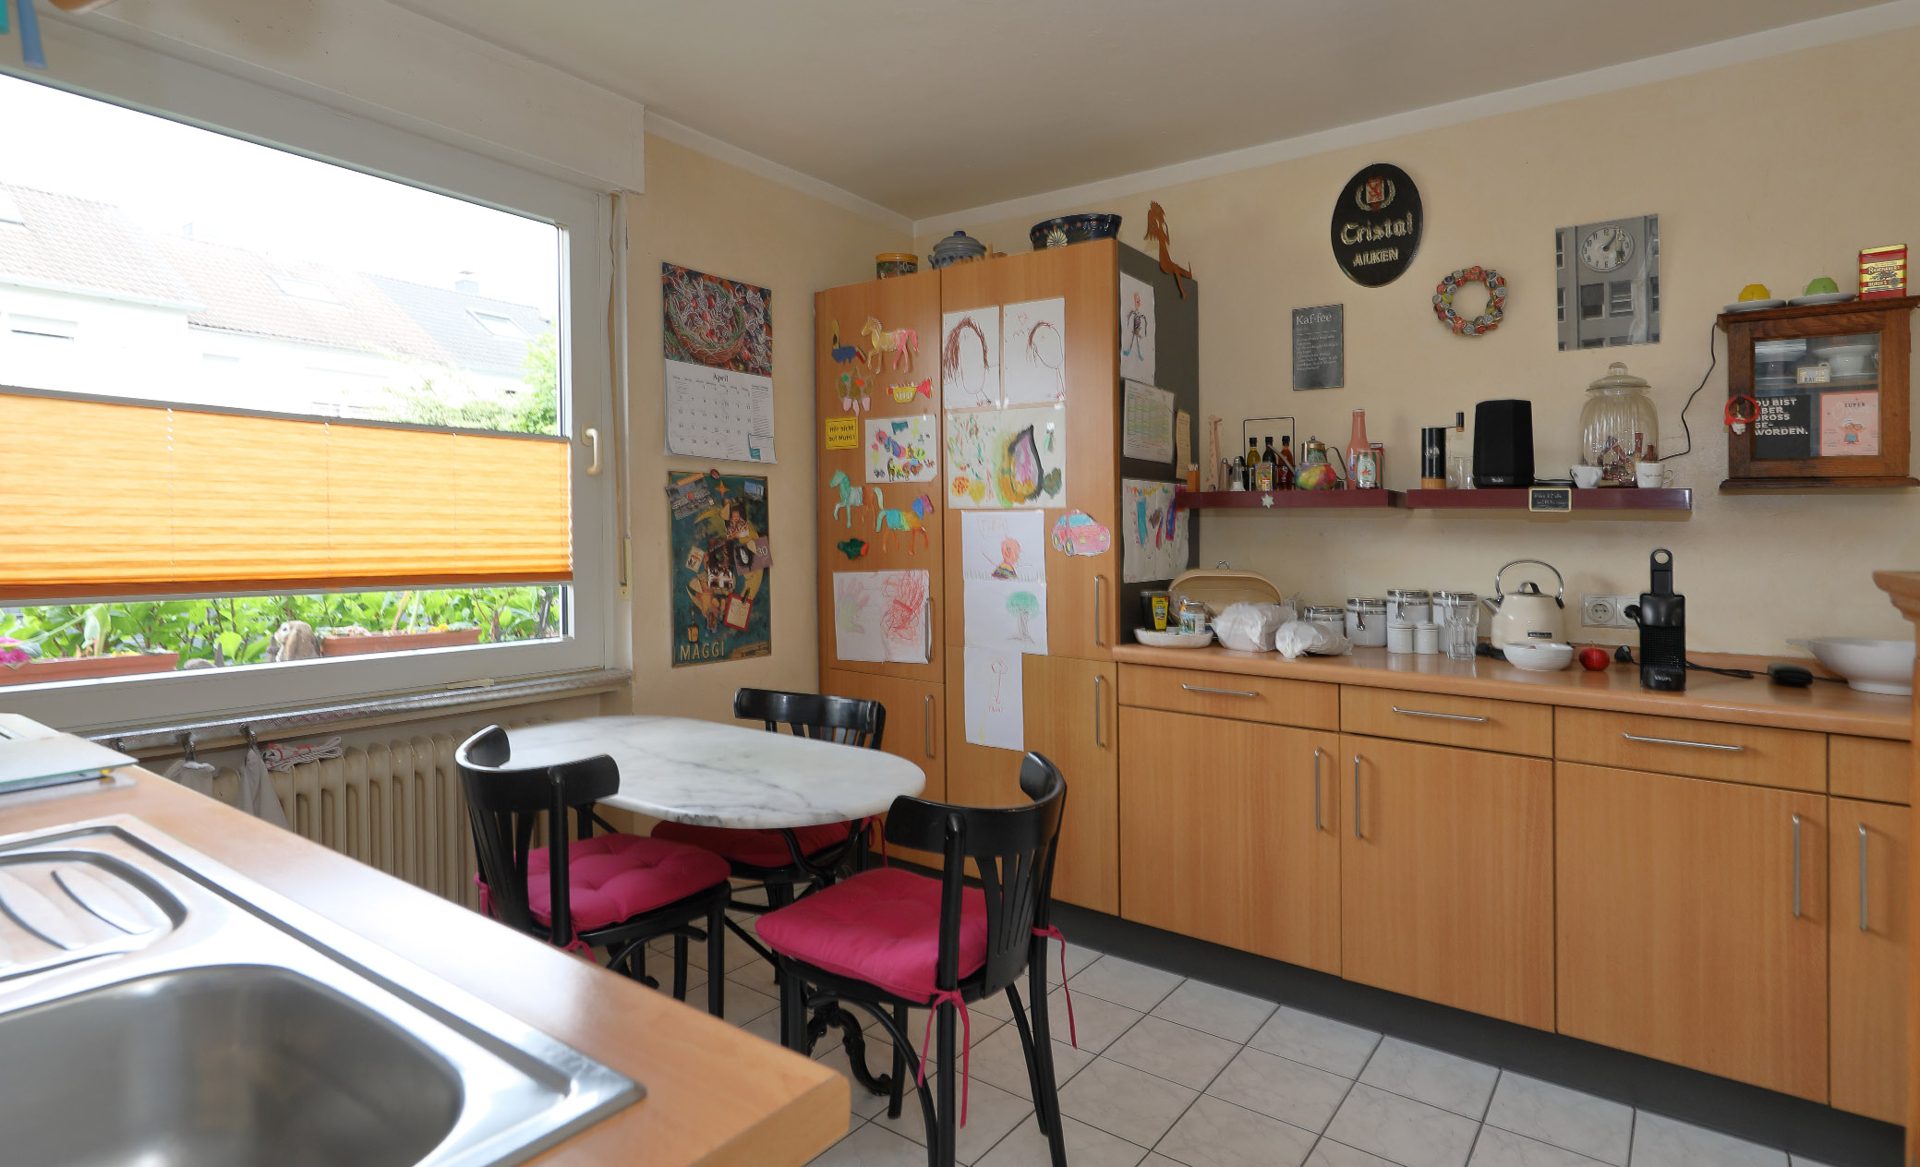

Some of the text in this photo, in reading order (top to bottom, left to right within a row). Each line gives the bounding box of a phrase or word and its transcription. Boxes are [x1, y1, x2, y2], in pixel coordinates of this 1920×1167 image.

[1340, 211, 1413, 246] Cristal
[713, 373, 729, 382] April
[1772, 398, 1797, 406] BIST
[1760, 406, 1784, 415] BER
[1754, 427, 1809, 436] WORDEN.
[680, 639, 725, 662] MAGGI
